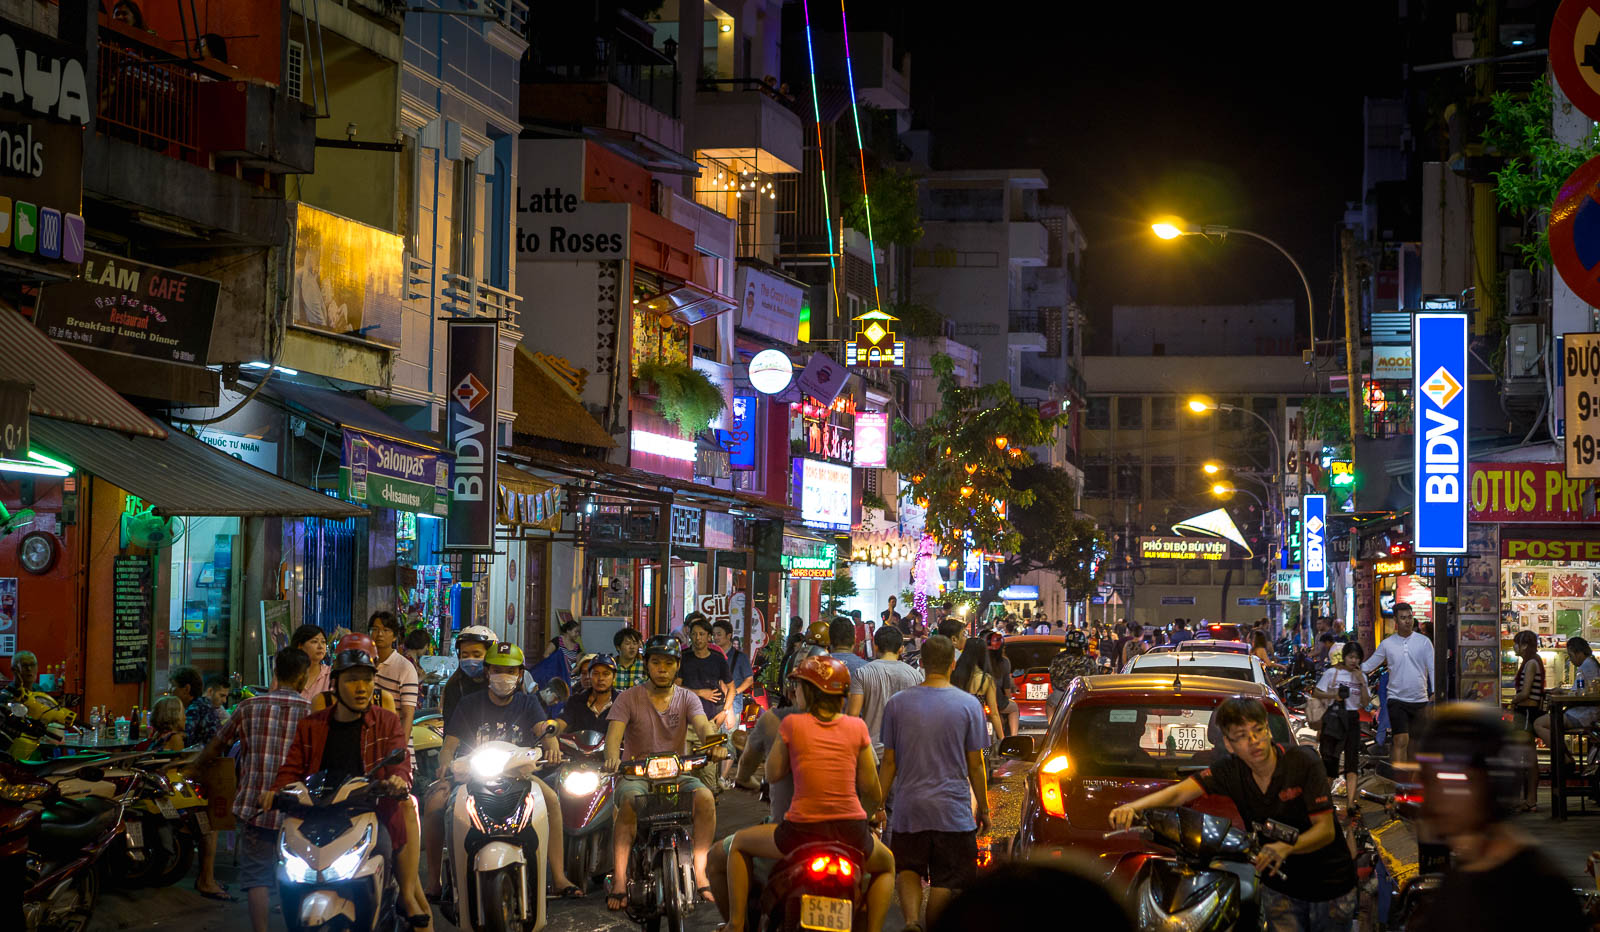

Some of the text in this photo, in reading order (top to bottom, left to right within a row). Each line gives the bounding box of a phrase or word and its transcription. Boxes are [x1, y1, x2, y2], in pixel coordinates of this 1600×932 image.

[517, 187, 578, 213] Latte
[517, 226, 623, 253] to Roses
[84, 260, 188, 303] LÂM CAFÉ
[66, 316, 116, 335] Breakfast
[118, 327, 147, 342] Lunch
[149, 332, 180, 347] Dinner
[110, 306, 150, 330] Restaurant
[376, 444, 425, 479] Salonpas
[454, 412, 485, 501] BIDV
[1425, 408, 1459, 503] BIDV
[382, 483, 421, 508] Hisamitsu
[1307, 532, 1323, 572] BIDV
[809, 569, 827, 577] CHECK
[1179, 728, 1197, 739] 51G
